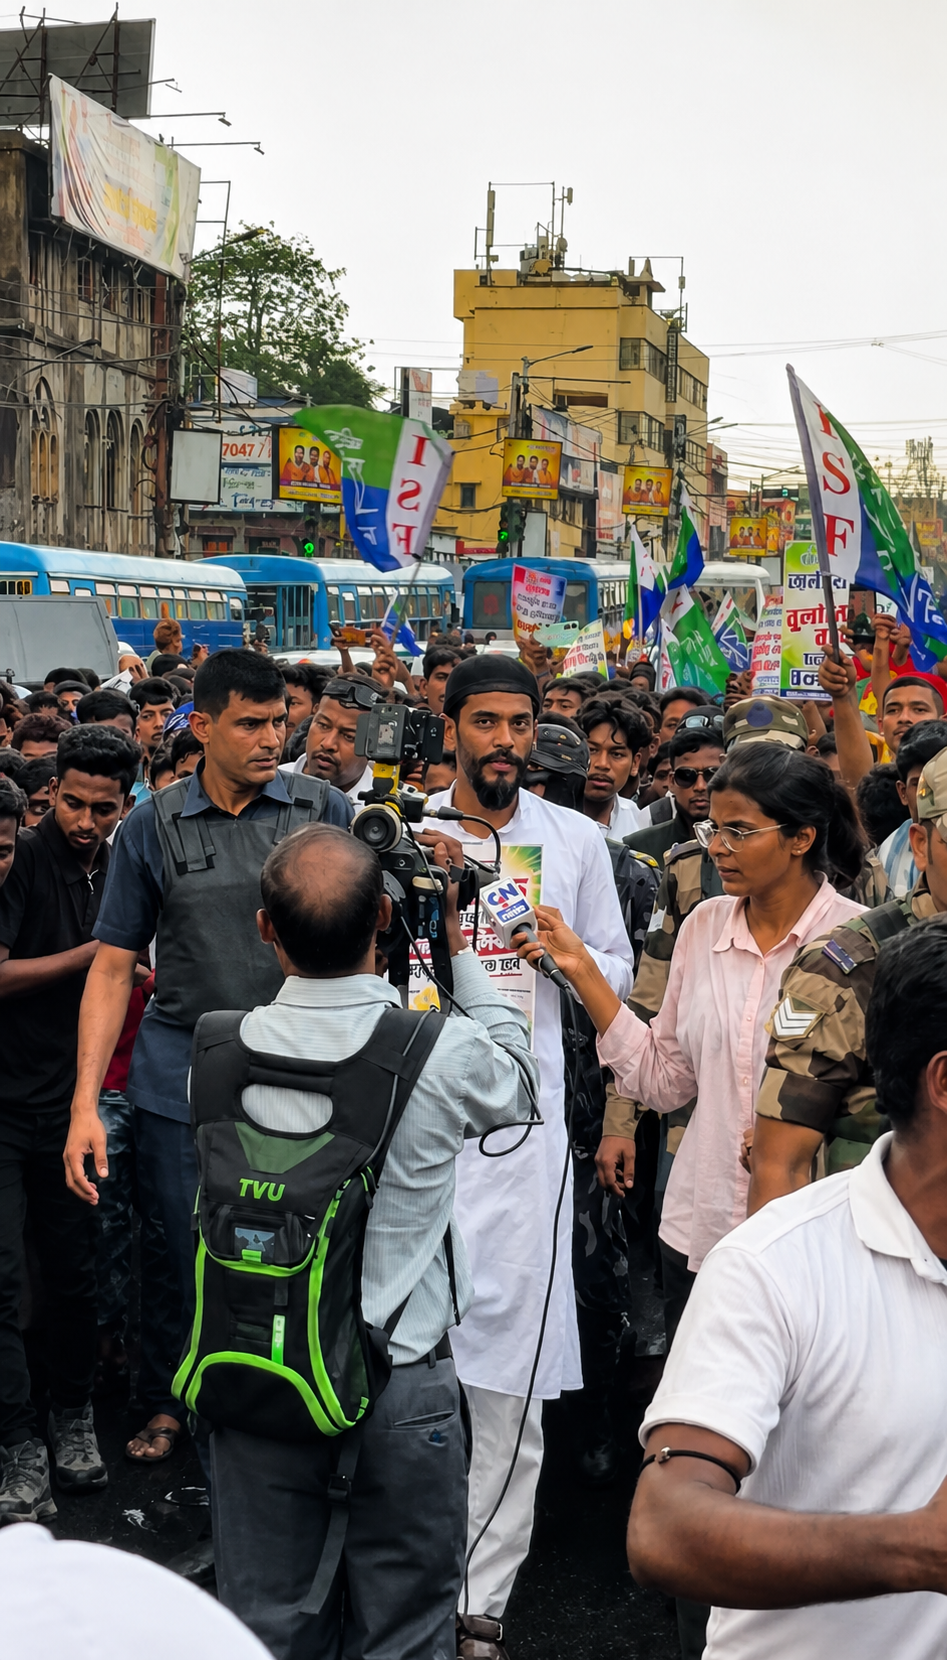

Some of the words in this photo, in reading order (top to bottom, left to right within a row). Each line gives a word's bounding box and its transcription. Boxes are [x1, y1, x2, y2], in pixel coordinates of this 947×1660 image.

[222, 443, 255, 457] 7047
[813, 401, 855, 557] ISF
[239, 1178, 286, 1201] TVU
